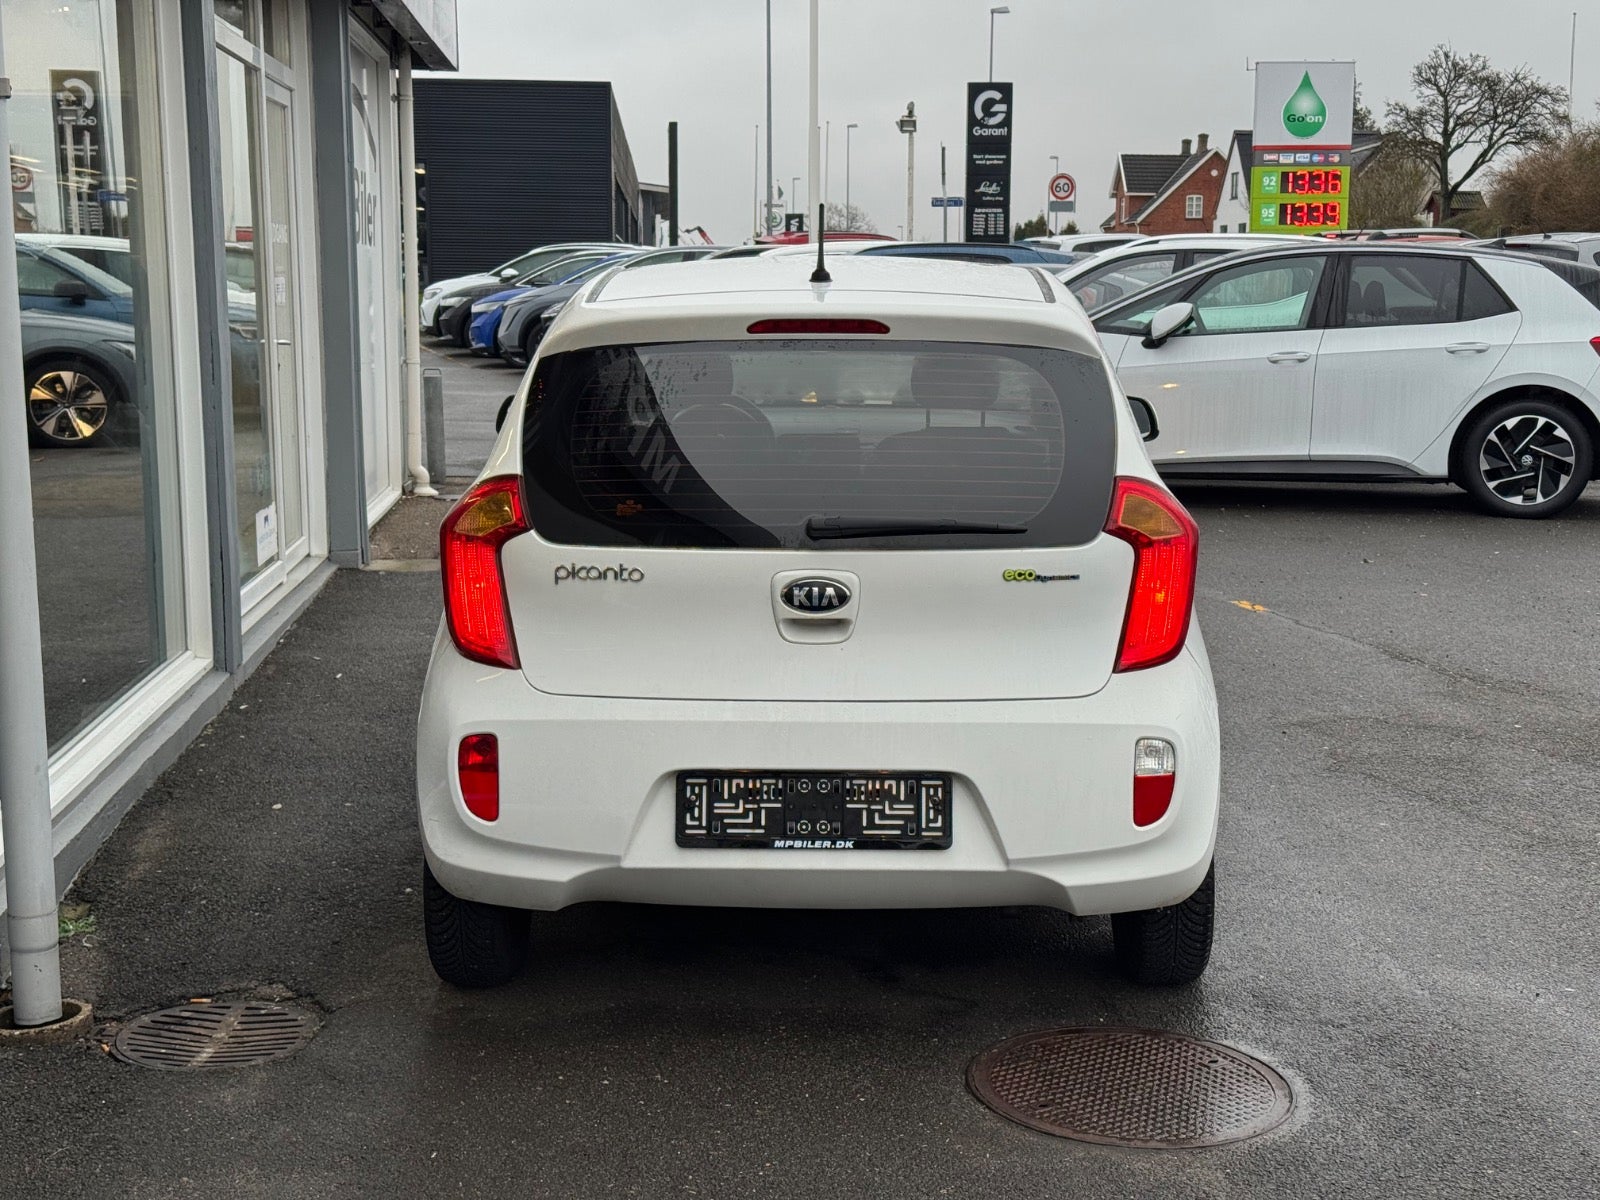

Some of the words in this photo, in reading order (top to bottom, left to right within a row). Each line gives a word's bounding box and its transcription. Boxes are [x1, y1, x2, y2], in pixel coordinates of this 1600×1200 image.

[1286, 113, 1323, 123] Go'on
[972, 126, 1008, 136] Garant
[1054, 182, 1070, 193] 60
[1262, 176, 1276, 186] 92
[1287, 169, 1342, 195] 13.36
[1261, 208, 1275, 218] 95
[1286, 202, 1341, 227] 13.39
[554, 562, 645, 585] picanto
[792, 586, 840, 607] KIA
[773, 839, 855, 849] MPBILER.DK
